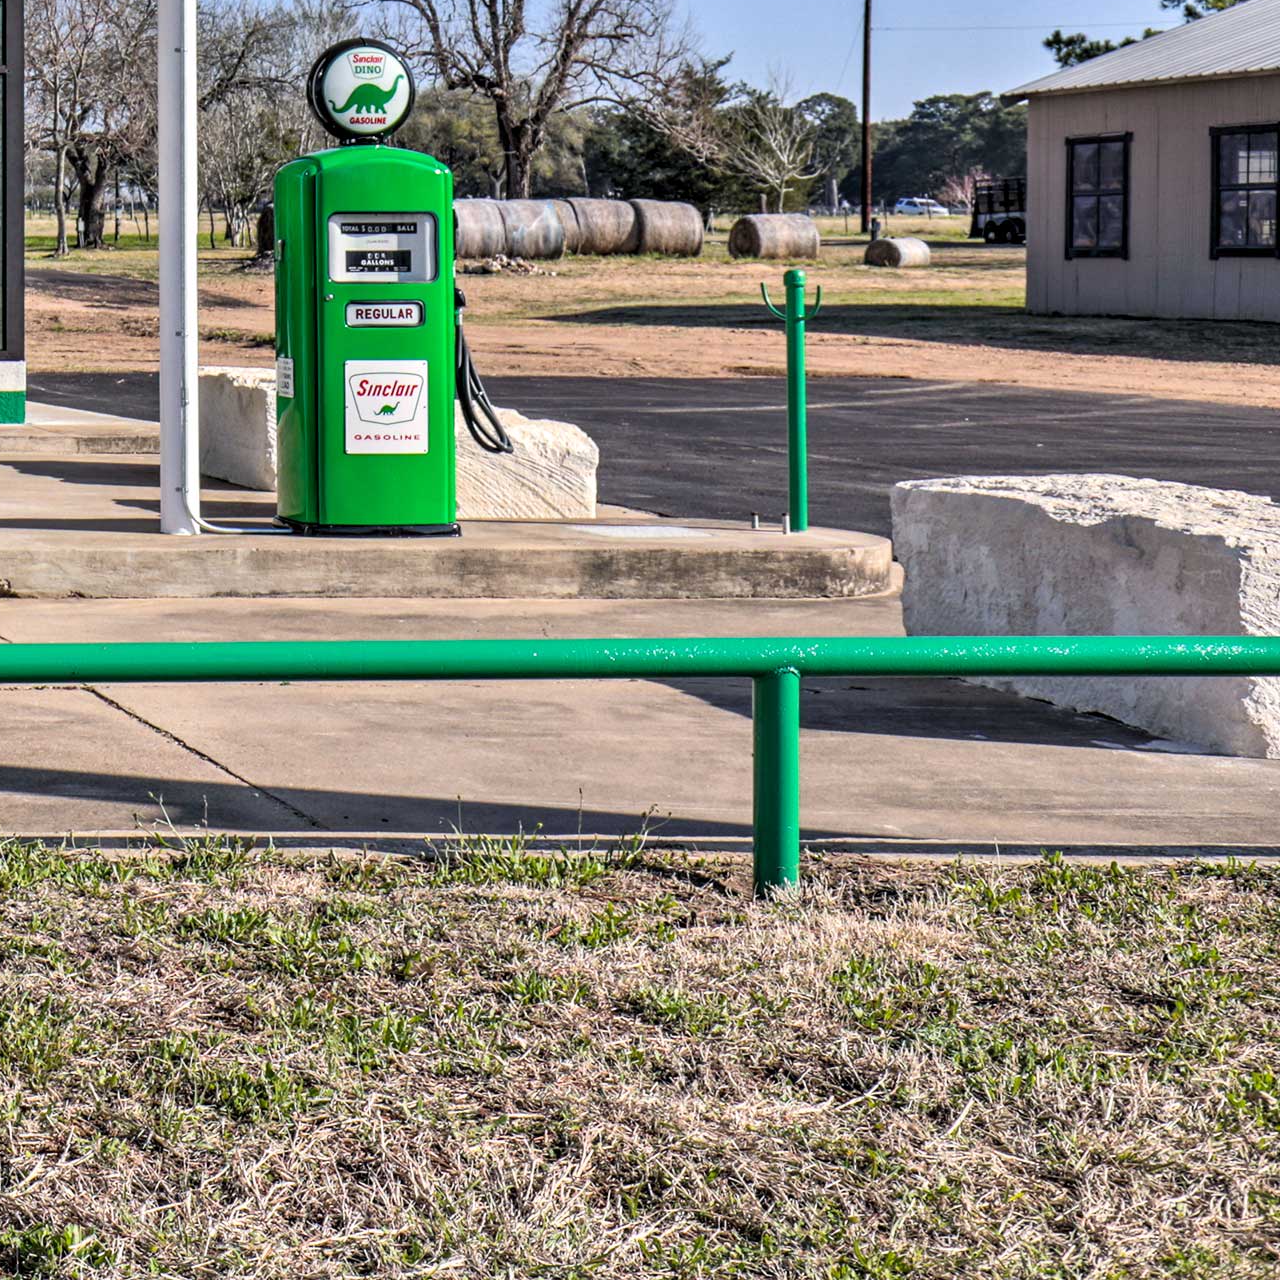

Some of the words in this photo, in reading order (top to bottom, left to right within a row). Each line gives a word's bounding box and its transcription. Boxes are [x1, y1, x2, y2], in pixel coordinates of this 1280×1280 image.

[352, 54, 383, 64] Sinclair
[354, 65, 382, 75] DINO
[349, 116, 387, 125] GASOLINE
[355, 308, 414, 320] REGULAR
[356, 379, 419, 398] Sinclair
